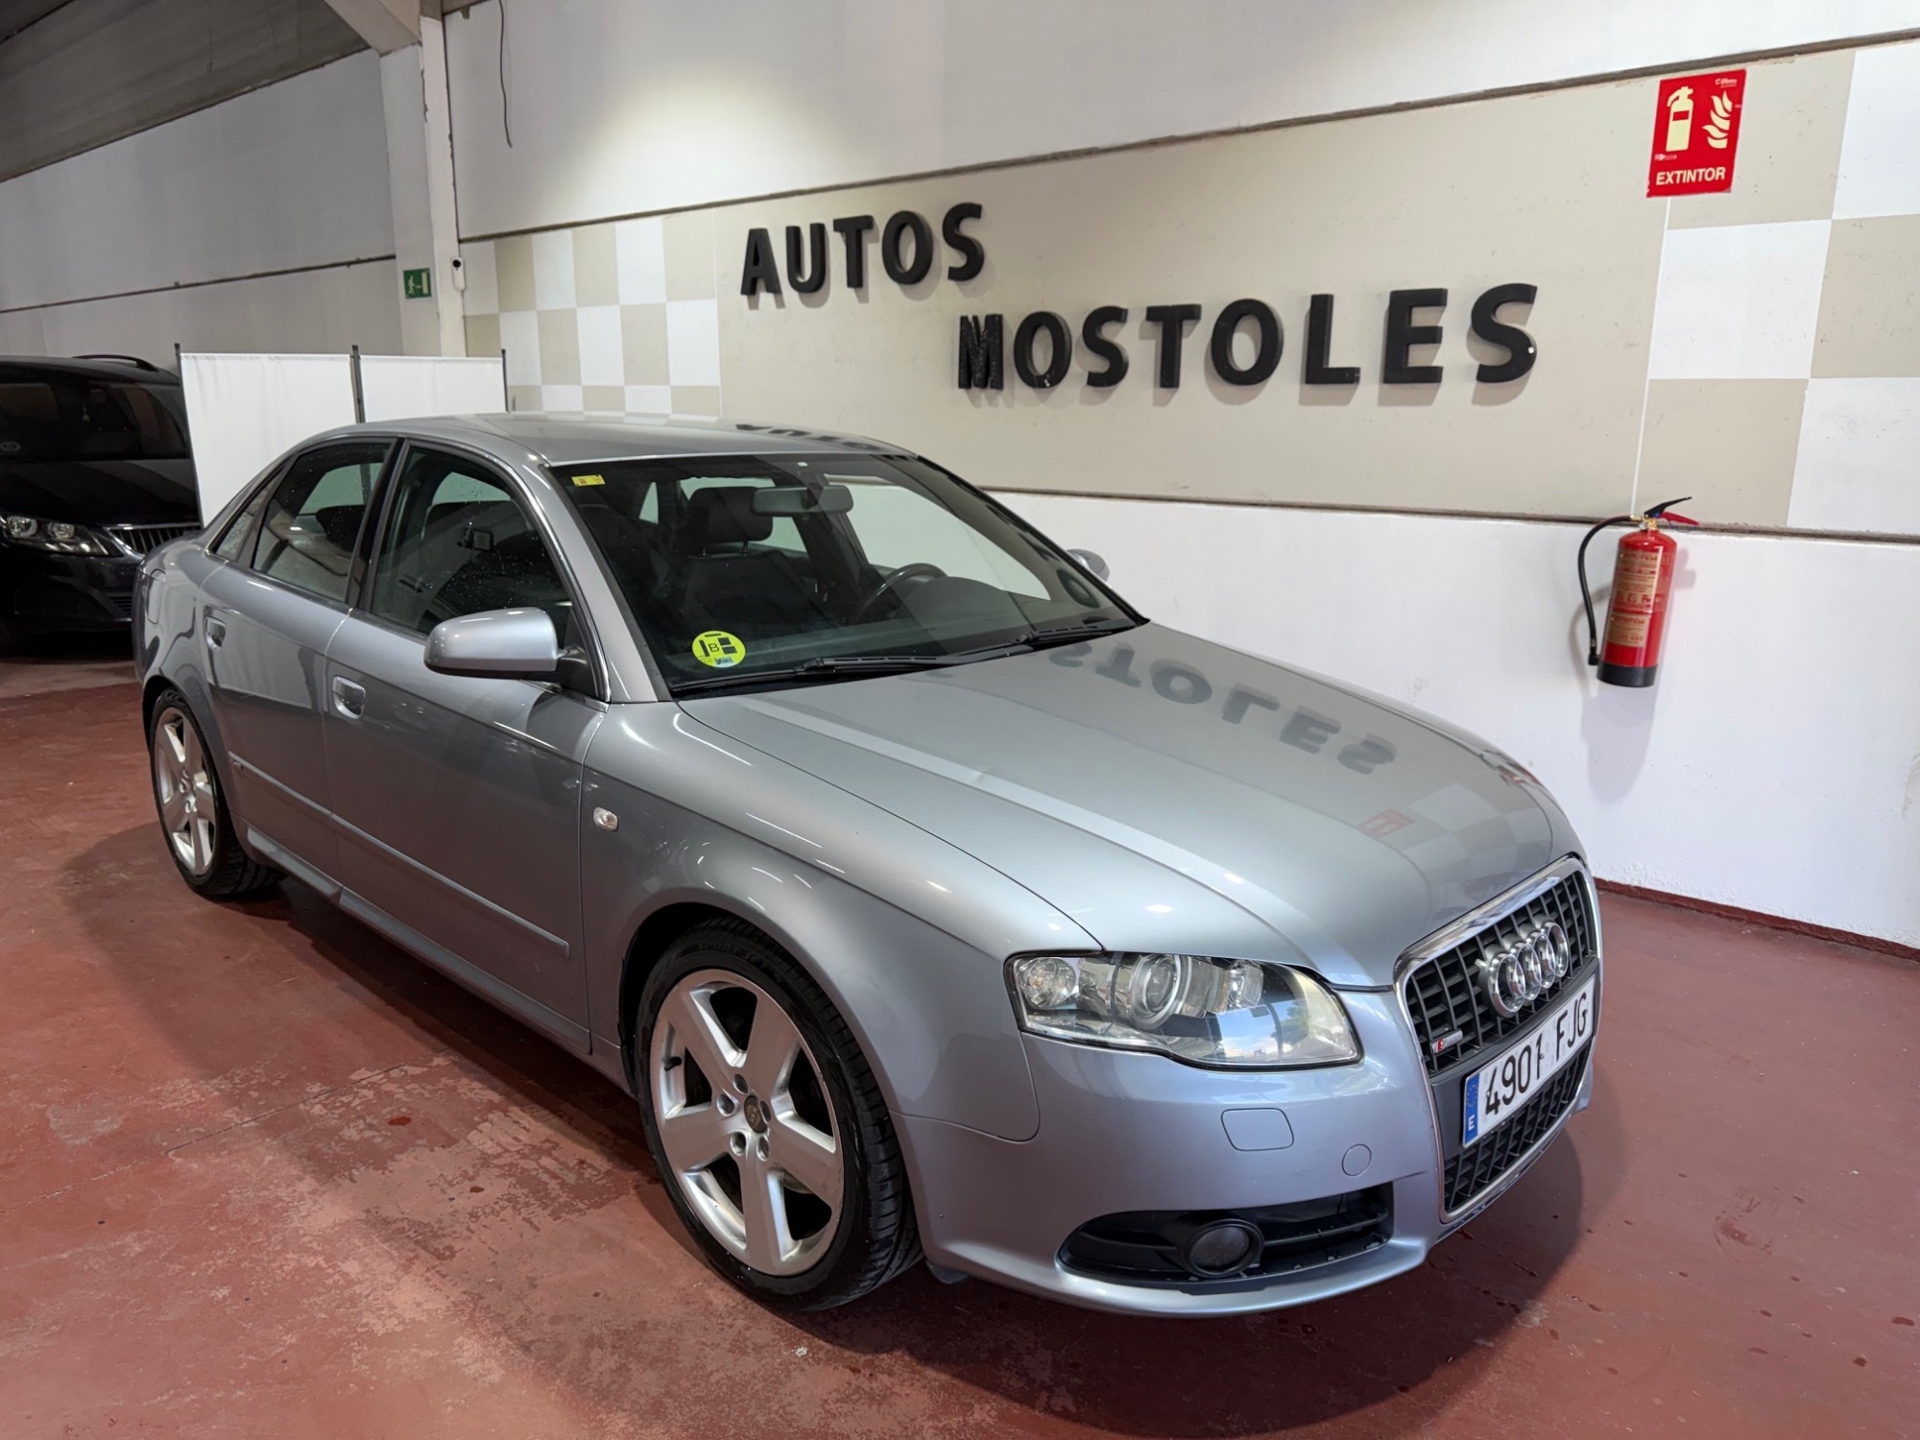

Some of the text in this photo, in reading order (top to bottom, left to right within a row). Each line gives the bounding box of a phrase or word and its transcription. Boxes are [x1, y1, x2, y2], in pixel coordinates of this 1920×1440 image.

[1655, 166, 1726, 186] EXTINTOR
[741, 203, 985, 297] AUTOS
[958, 283, 1537, 390] MOSTOLES
[708, 643, 719, 653] B
[1485, 991, 1588, 1116] 4901 FJG
[1468, 1114, 1475, 1131] E
